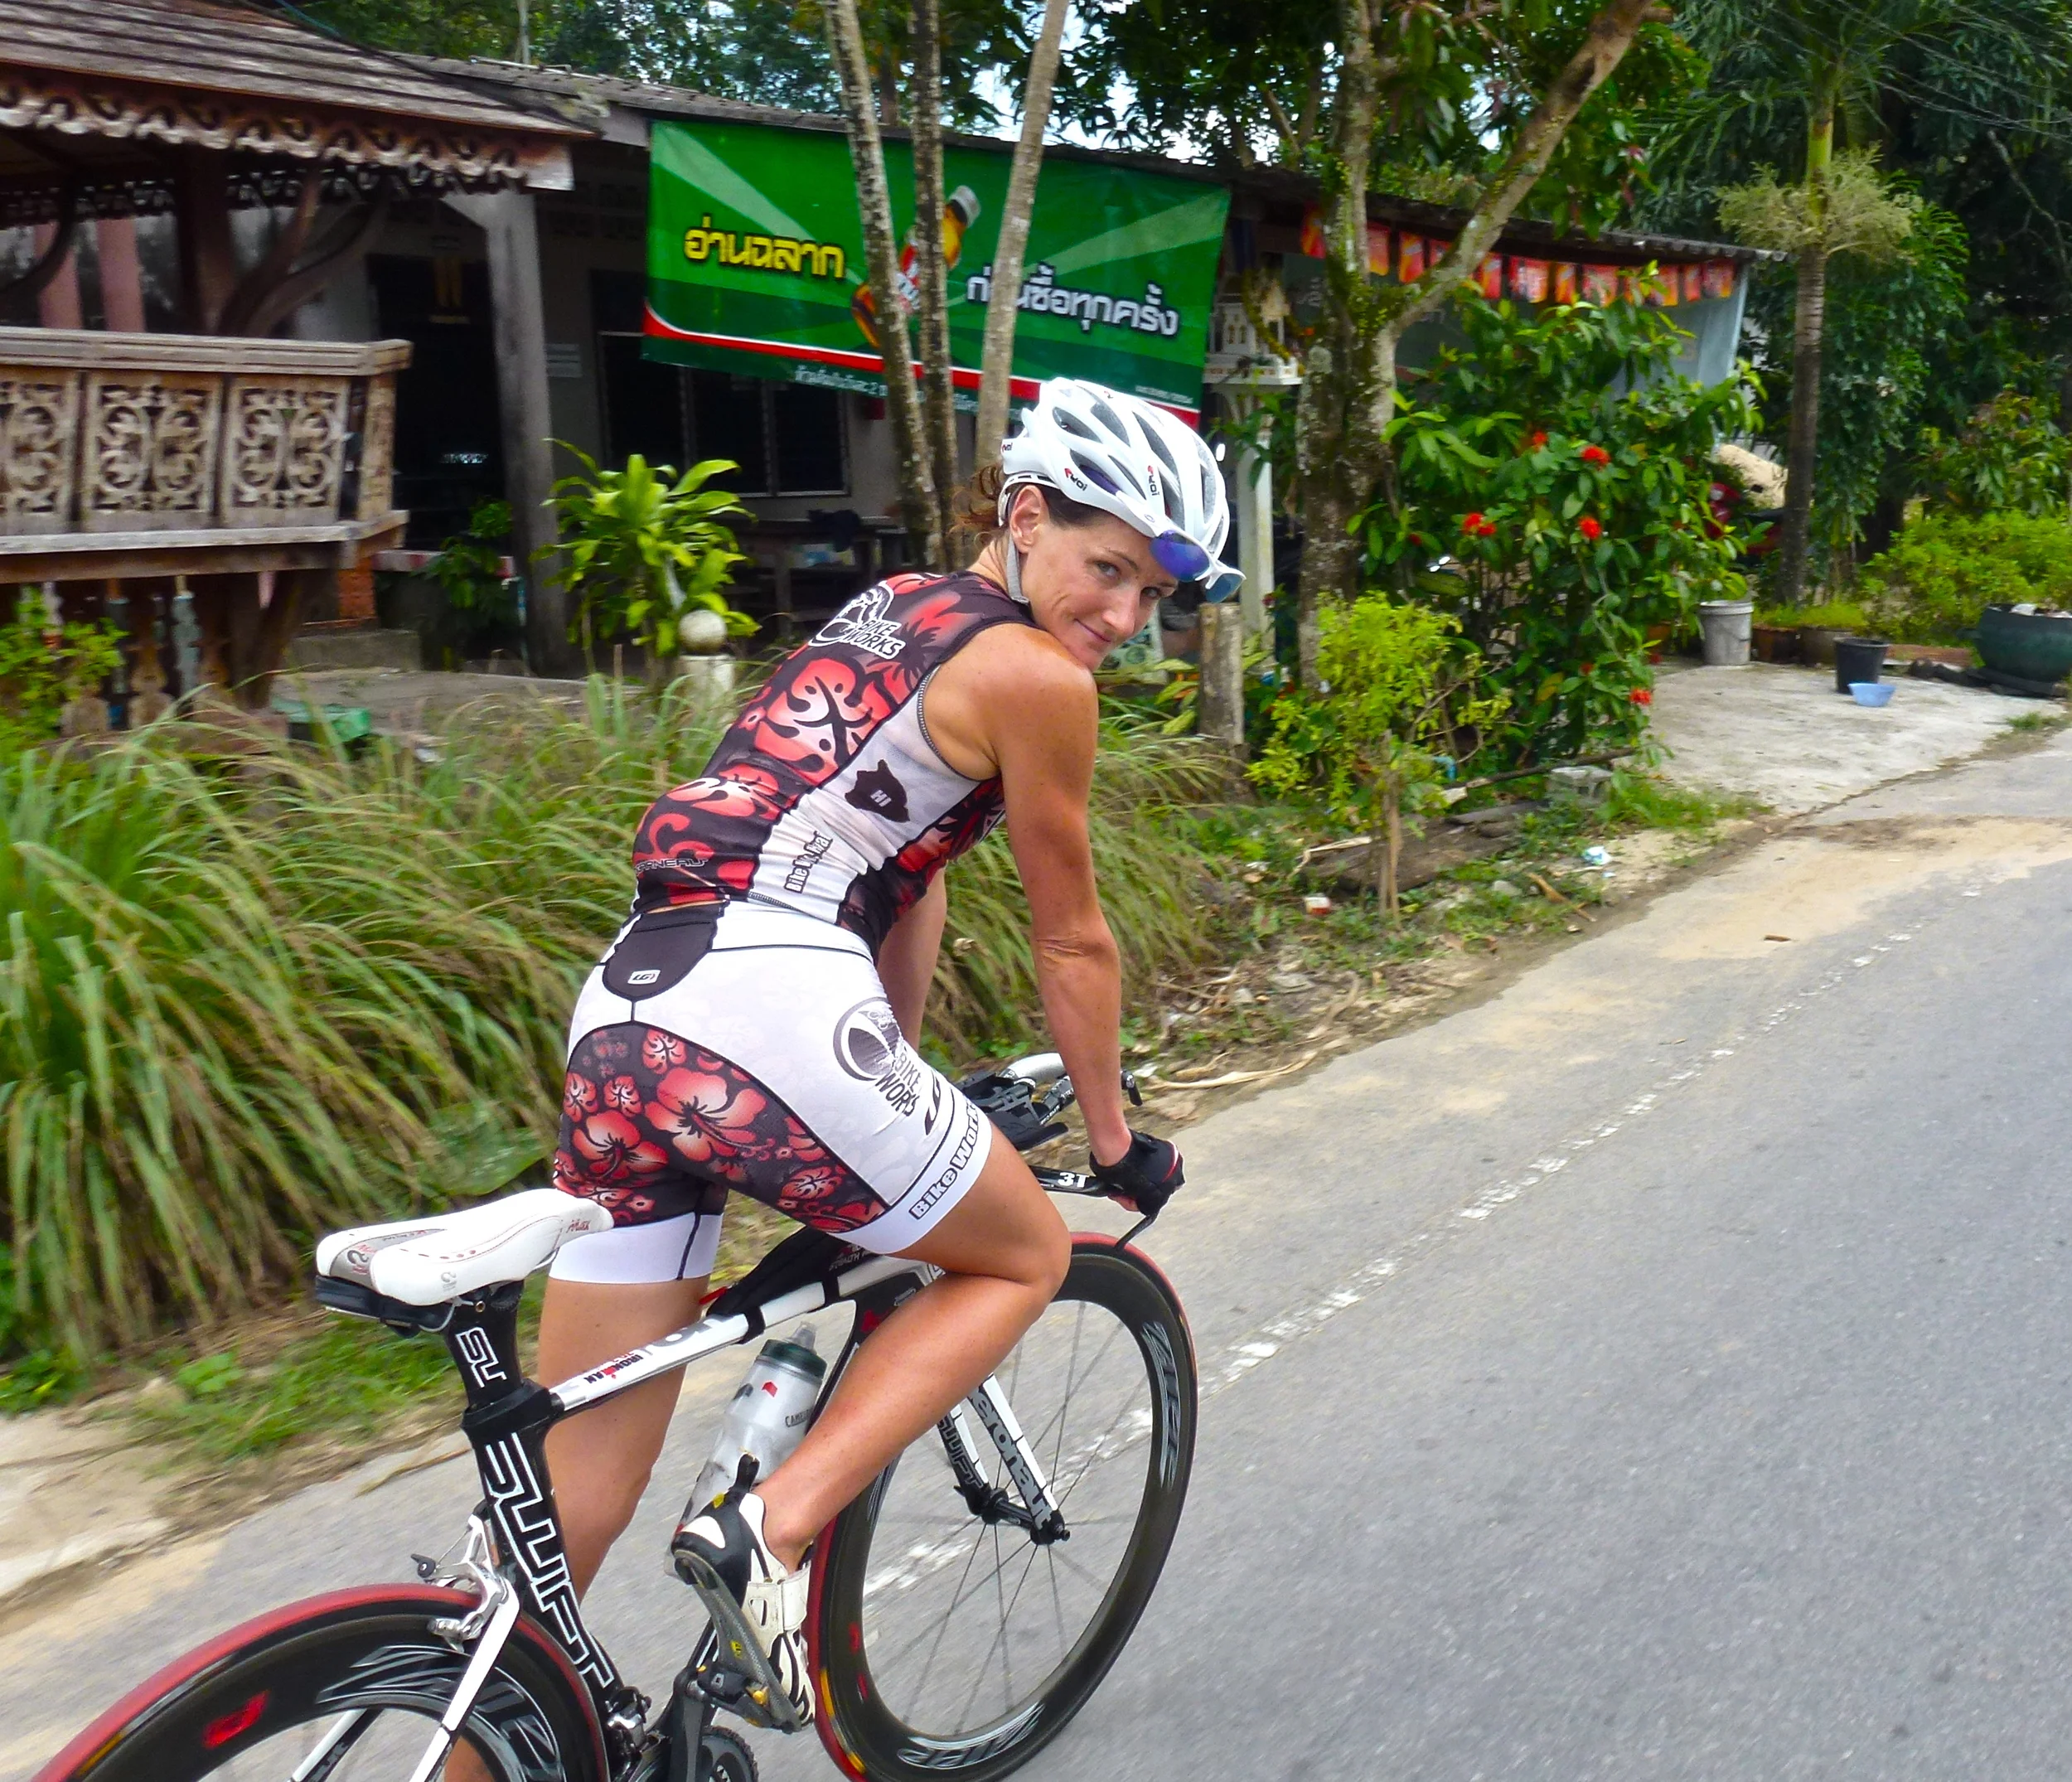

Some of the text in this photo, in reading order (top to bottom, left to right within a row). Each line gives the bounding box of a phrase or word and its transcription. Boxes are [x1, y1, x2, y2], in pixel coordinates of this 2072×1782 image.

[684, 215, 845, 278] อ่านฉลาก
[966, 263, 1179, 337] ก่นซื้อทุกครั้ง
[857, 619, 898, 637] BIKE
[842, 630, 903, 656] WORKS
[870, 789, 892, 807] HI
[908, 1167, 958, 1220] Bike
[1058, 1172, 1091, 1189] 3T
